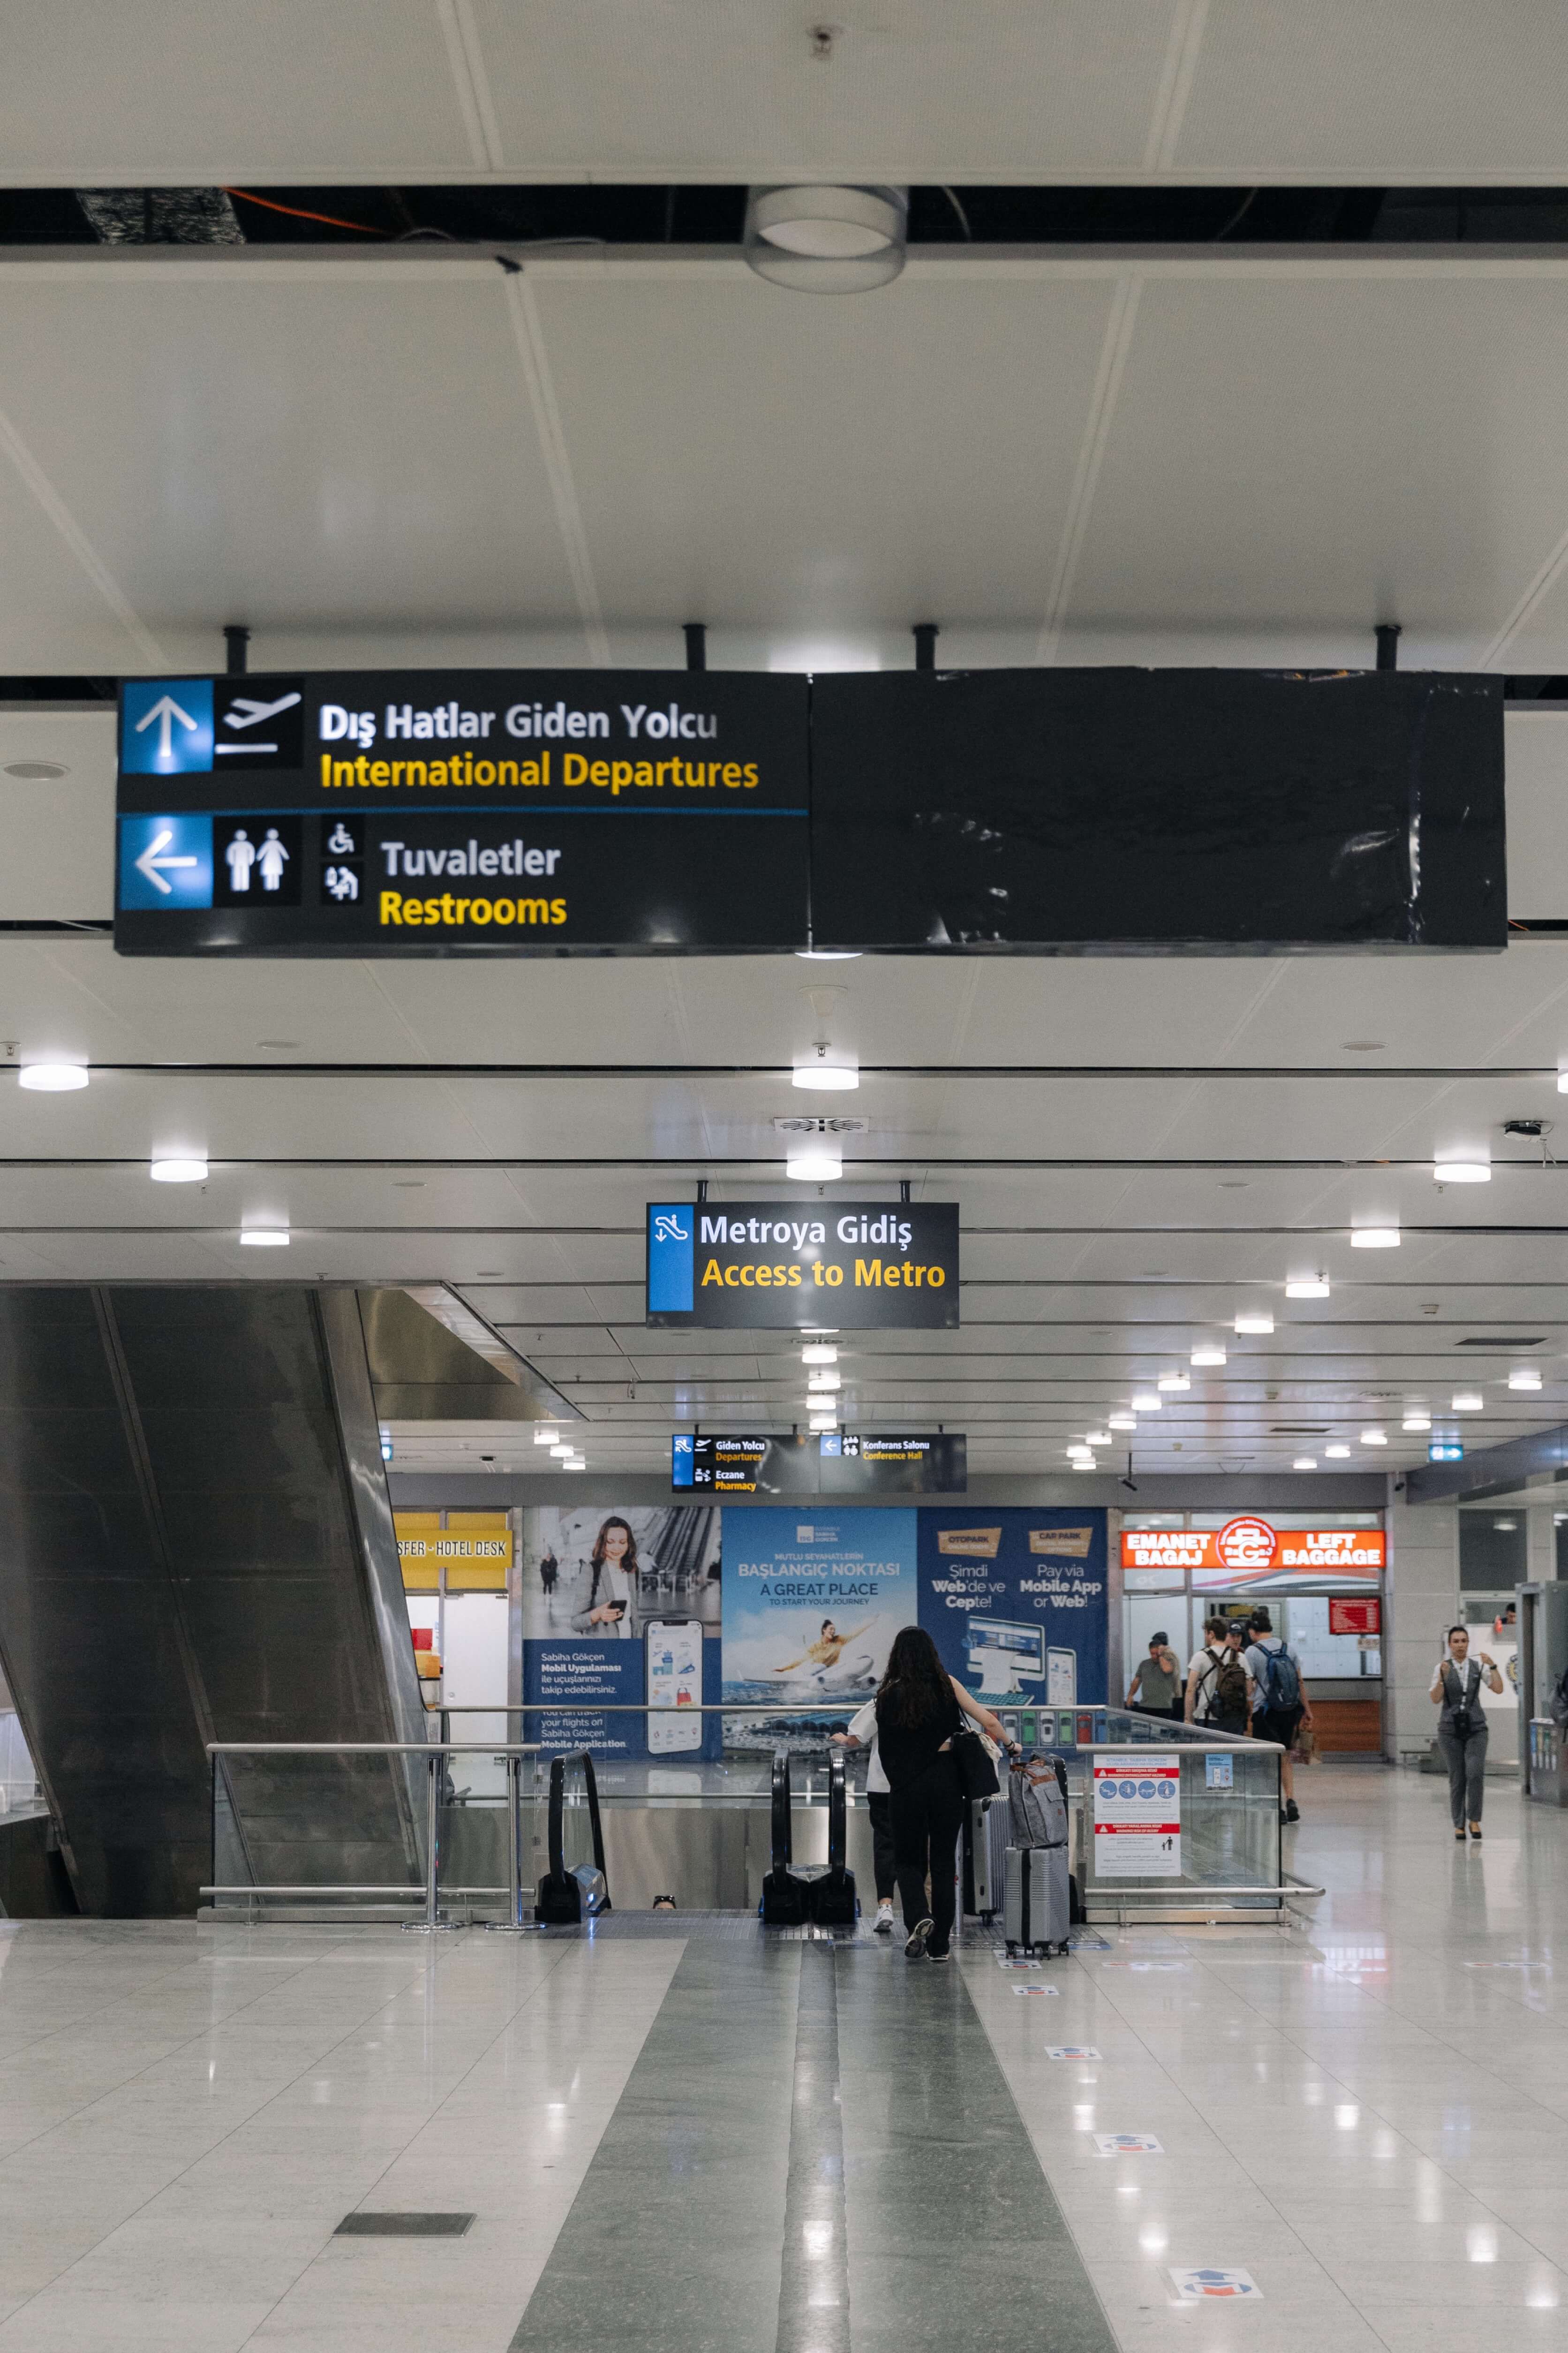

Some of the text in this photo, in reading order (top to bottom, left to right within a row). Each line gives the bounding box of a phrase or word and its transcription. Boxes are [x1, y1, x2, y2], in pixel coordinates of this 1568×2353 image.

[321, 702, 717, 747] Dış Hatlar Giden Yolcu
[321, 752, 759, 795] International Departures
[381, 840, 561, 877] Tuvaletler
[380, 892, 566, 926] Restrooms
[701, 1215, 912, 1251] Metroya Gidiş
[701, 1259, 945, 1287] Access to Metro
[716, 1441, 765, 1450] Giden Yolcu
[863, 1440, 929, 1449] Konferans Salonu
[716, 1452, 762, 1463] Departures
[863, 1451, 923, 1460] Conference Hall
[716, 1470, 745, 1479] Eczane
[715, 1481, 756, 1492] Pharmacy
[436, 1541, 472, 1556] HOTEL
[475, 1541, 506, 1556] DESK
[1127, 1534, 1211, 1550] EMANET
[1306, 1534, 1356, 1549] LEFT
[1135, 1551, 1203, 1566] BAGAJ
[1282, 1549, 1381, 1565] BAGGAGE
[832, 1563, 900, 1576] NOKTASI
[950, 1564, 988, 1580] Şimdi
[1037, 1565, 1084, 1580] Pay via
[760, 1583, 878, 1595] A GREAT PLACE
[989, 1582, 1006, 1593] ve
[1020, 1580, 1102, 1595] Mobile App
[945, 1596, 992, 1611] Cepte!
[1033, 1596, 1088, 1608] or Web!
[572, 1652, 605, 1662] Gökçen
[568, 1664, 622, 1673] Uygulaması
[541, 1686, 563, 1695] takip
[541, 1720, 561, 1729] your
[562, 1718, 589, 1728] flights
[572, 1729, 605, 1739] Gökçen
